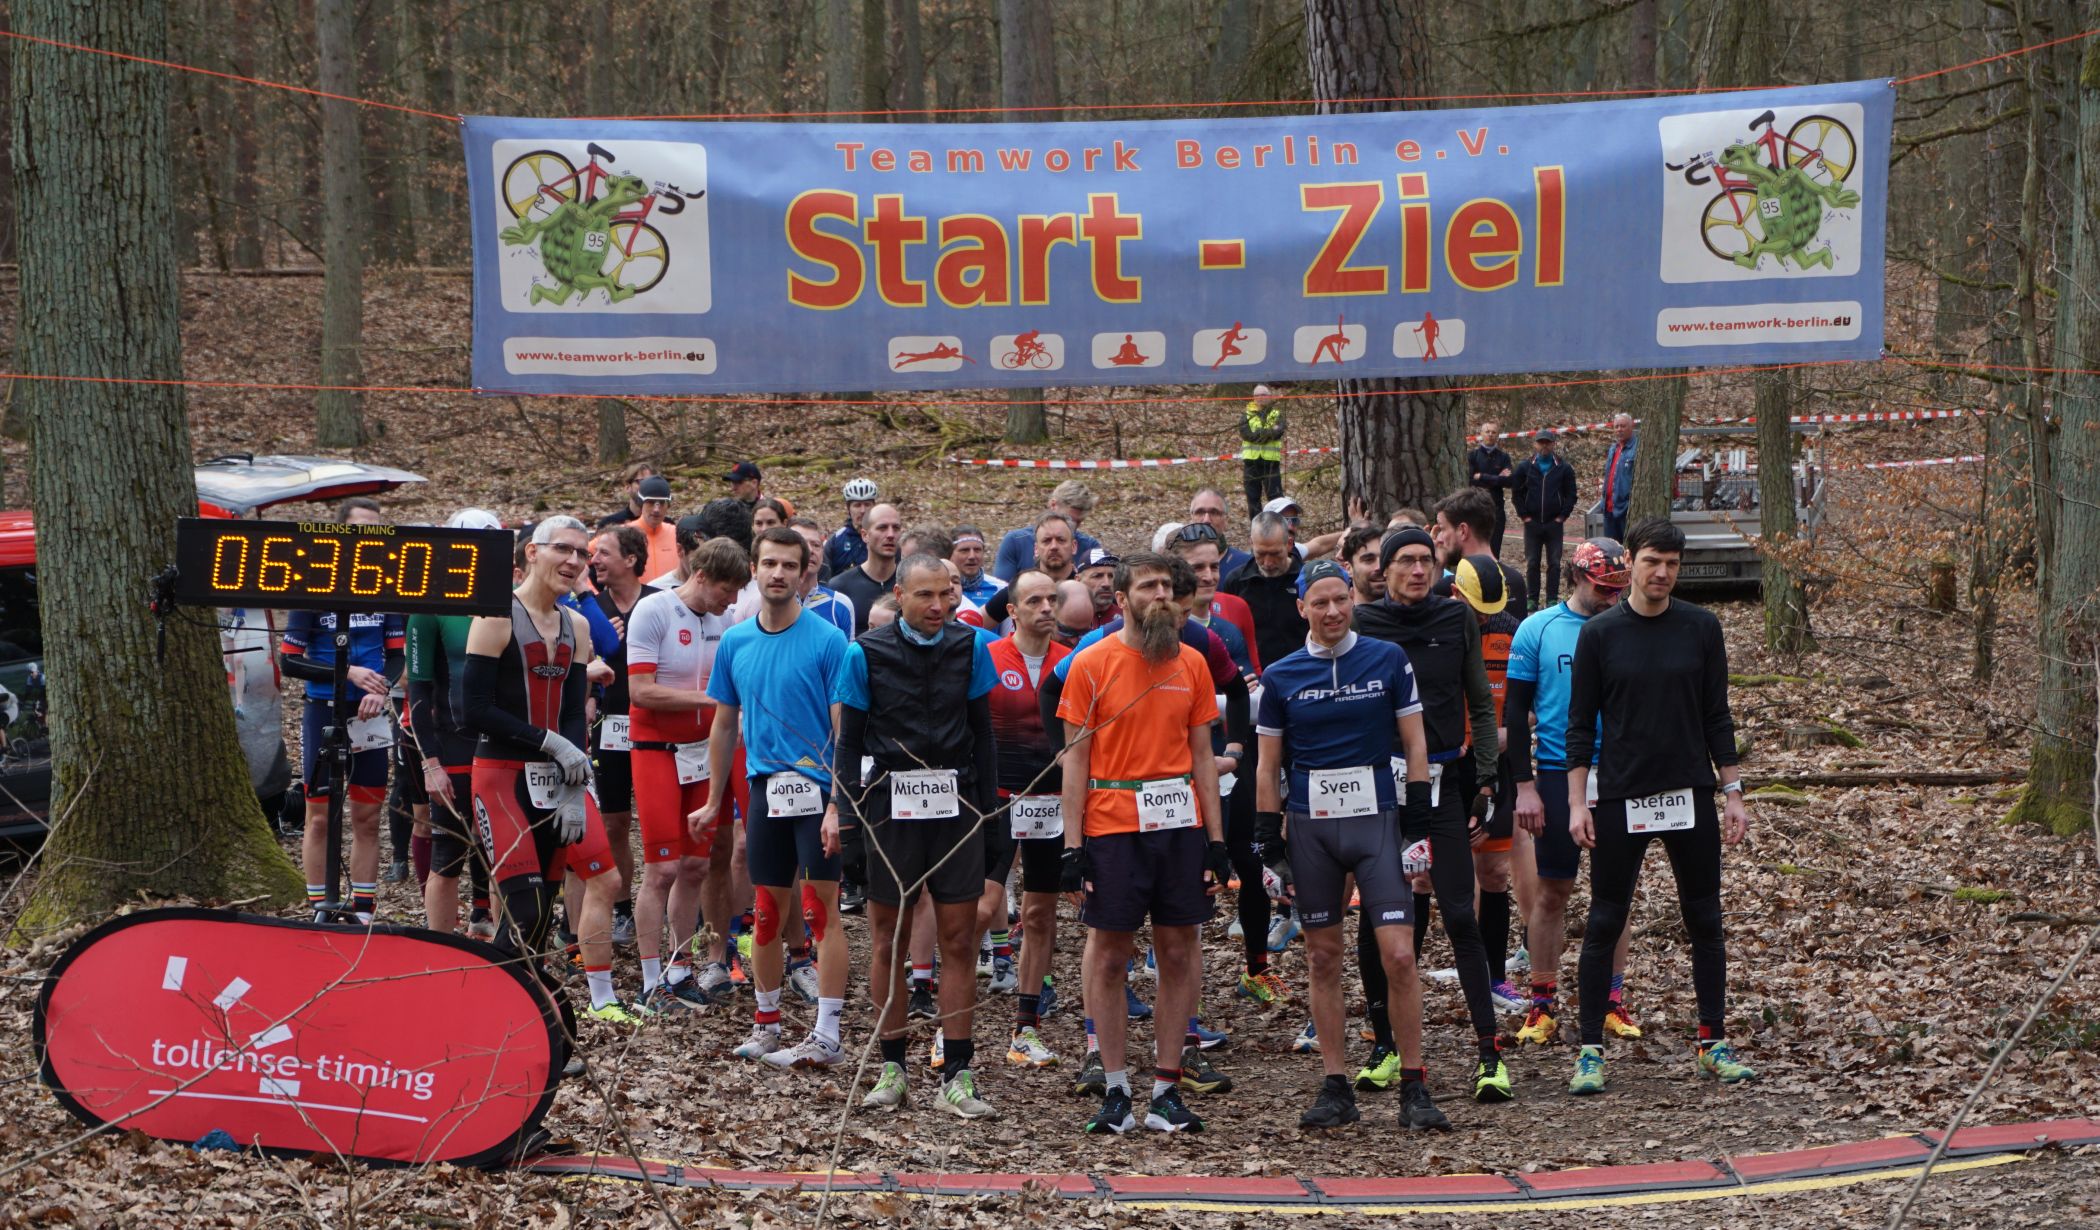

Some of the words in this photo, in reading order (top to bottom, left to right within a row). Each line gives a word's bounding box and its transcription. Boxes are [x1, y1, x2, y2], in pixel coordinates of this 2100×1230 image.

[836, 141, 1142, 173] Teamwork
[1175, 135, 1359, 170] Berlin
[1396, 126, 1510, 161] e.V.
[1762, 201, 1779, 214] 95
[588, 233, 605, 249] 95
[785, 188, 1143, 311] Start
[1198, 238, 1246, 270] -
[1299, 165, 1566, 297] Ziel
[1668, 316, 1852, 333] www.teamwork-berlin.eu
[516, 350, 706, 363] www.teamwork-berlin.eu
[298, 522, 396, 536] TOLLENSE-TIMING
[211, 535, 479, 599] 06:36:03
[613, 722, 630, 733] Dir
[771, 782, 812, 795] Jonas
[894, 779, 955, 796] Michael
[1320, 779, 1361, 795] Sven
[922, 799, 928, 808] 8
[1143, 790, 1189, 807] Ronny
[1015, 804, 1060, 818] Jozsef
[1165, 808, 1176, 818] 22
[1352, 806, 1371, 814] uvex
[1654, 811, 1665, 820] 29
[152, 1039, 435, 1100] tollense-timing
